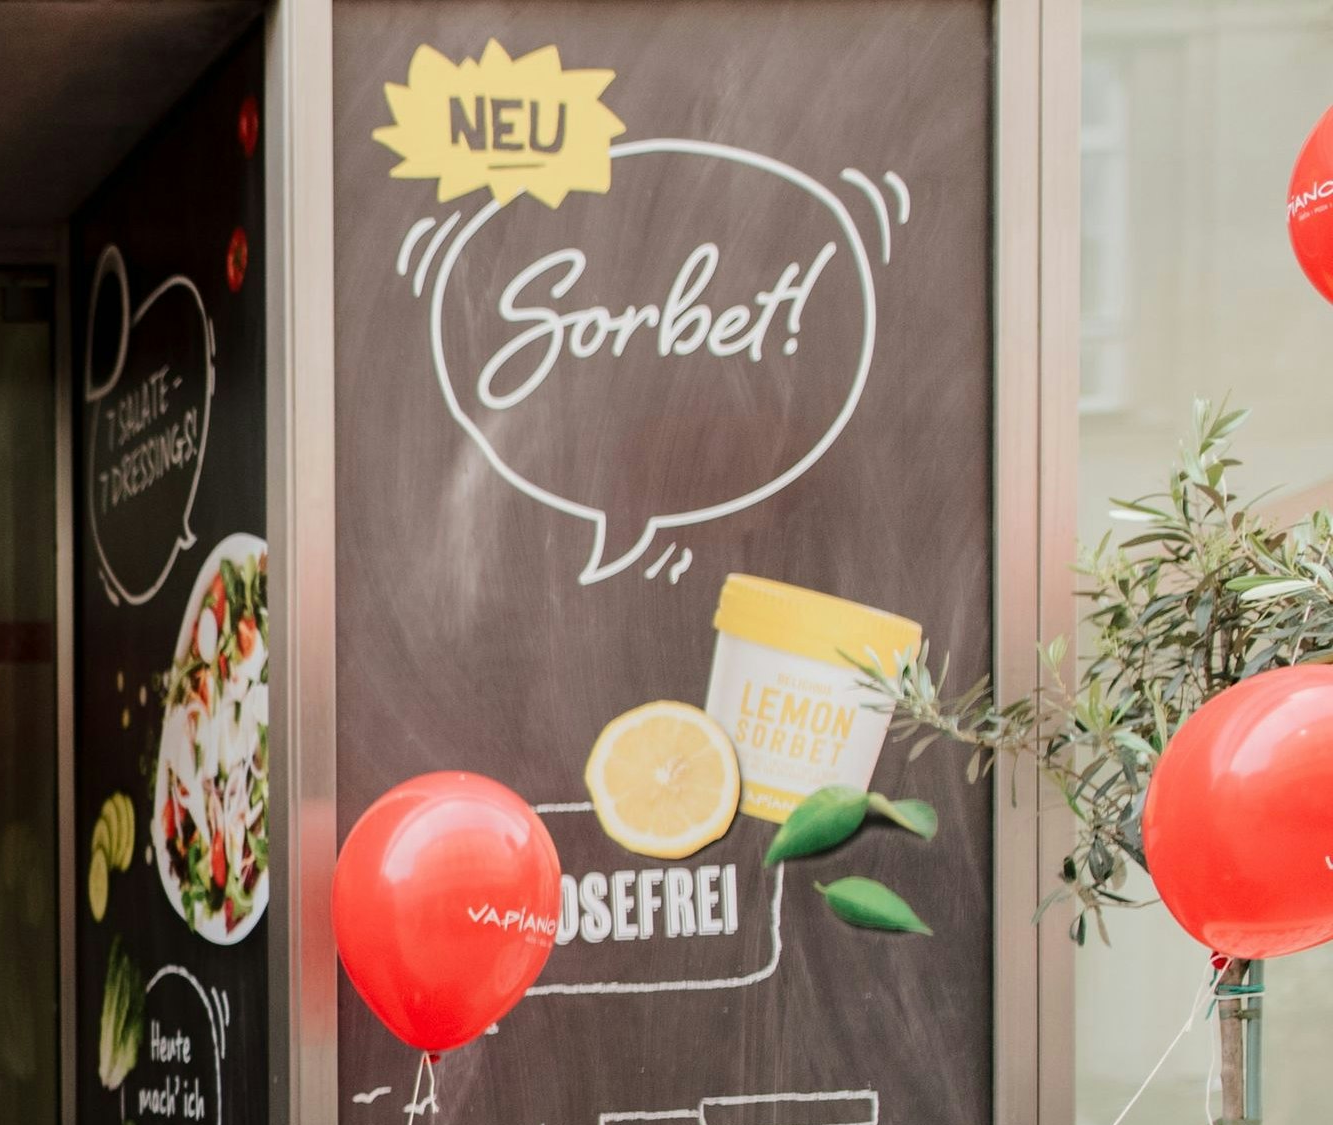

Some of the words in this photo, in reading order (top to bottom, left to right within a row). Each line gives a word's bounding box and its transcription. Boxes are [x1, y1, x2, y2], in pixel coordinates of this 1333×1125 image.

[448, 96, 567, 153] NEU
[478, 242, 836, 409] Sorbet!
[740, 679, 856, 740] LEMON
[735, 718, 847, 767] SORBET
[151, 1020, 191, 1064] Heute
[184, 1077, 205, 1121] ich
